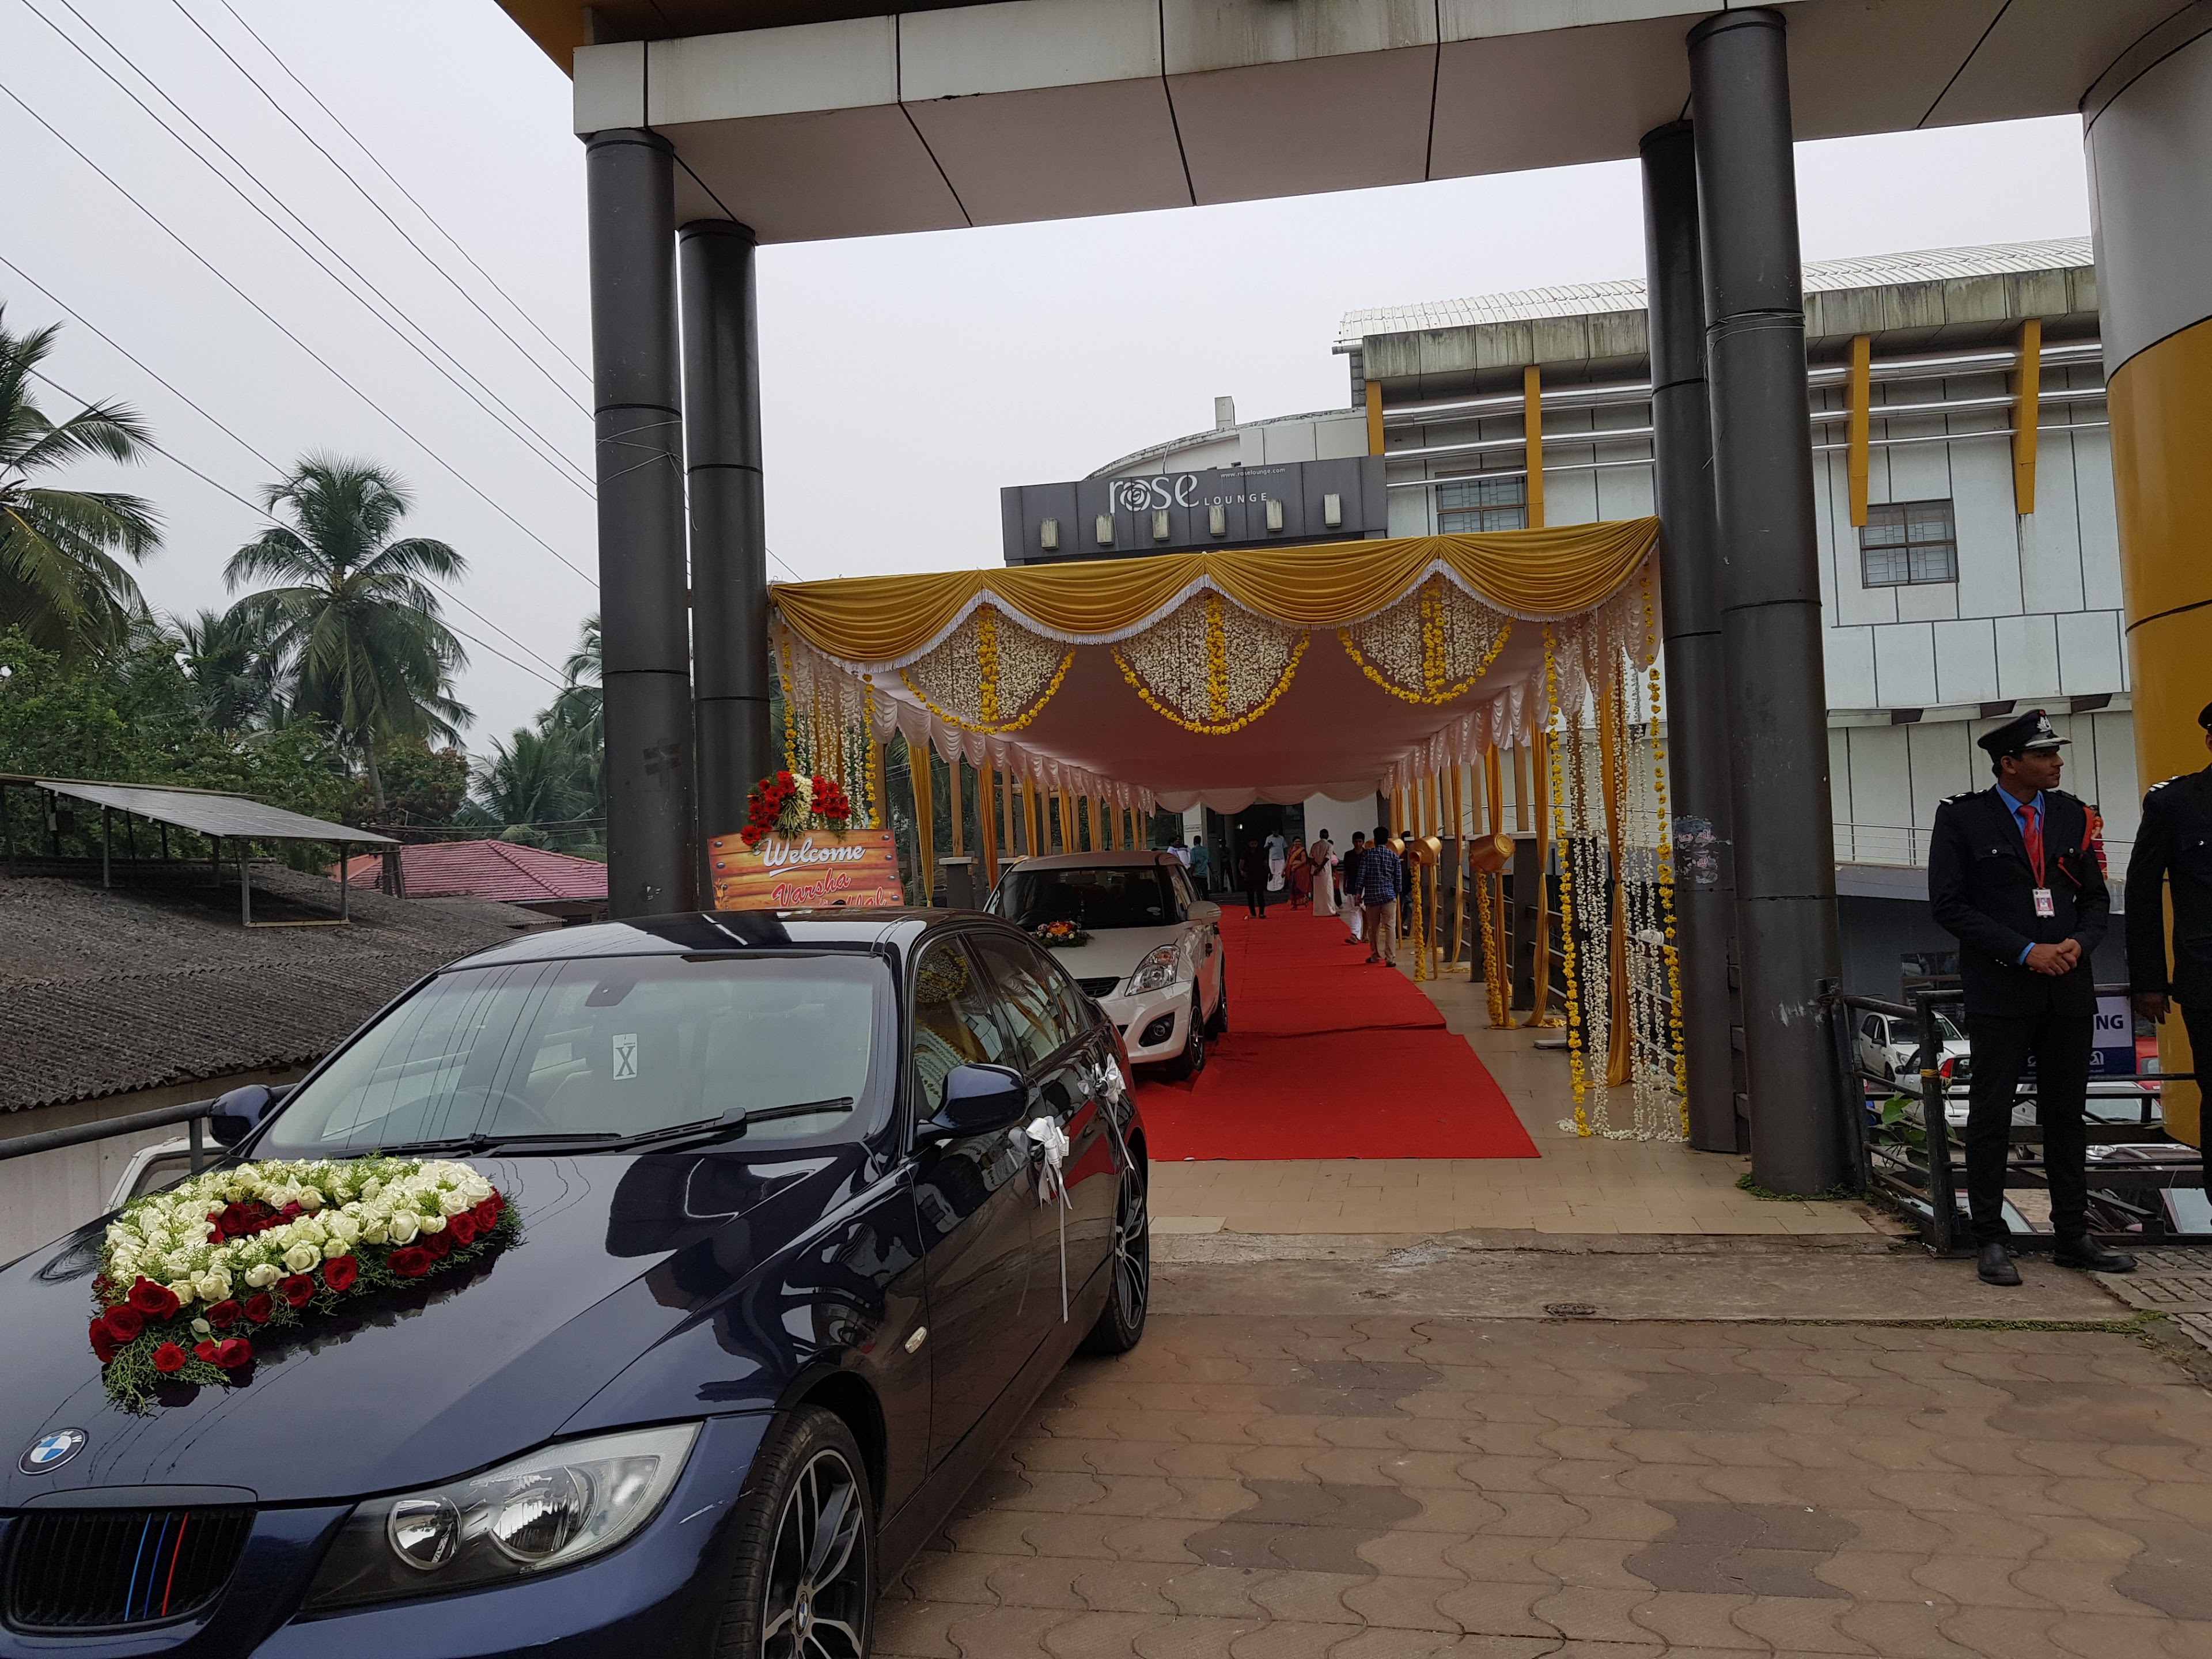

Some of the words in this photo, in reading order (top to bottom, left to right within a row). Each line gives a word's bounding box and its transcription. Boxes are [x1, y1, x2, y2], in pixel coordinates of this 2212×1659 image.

[1204, 492, 1267, 506] LOUNGE
[753, 837, 866, 867] Welcome
[771, 868, 851, 907] Varsha
